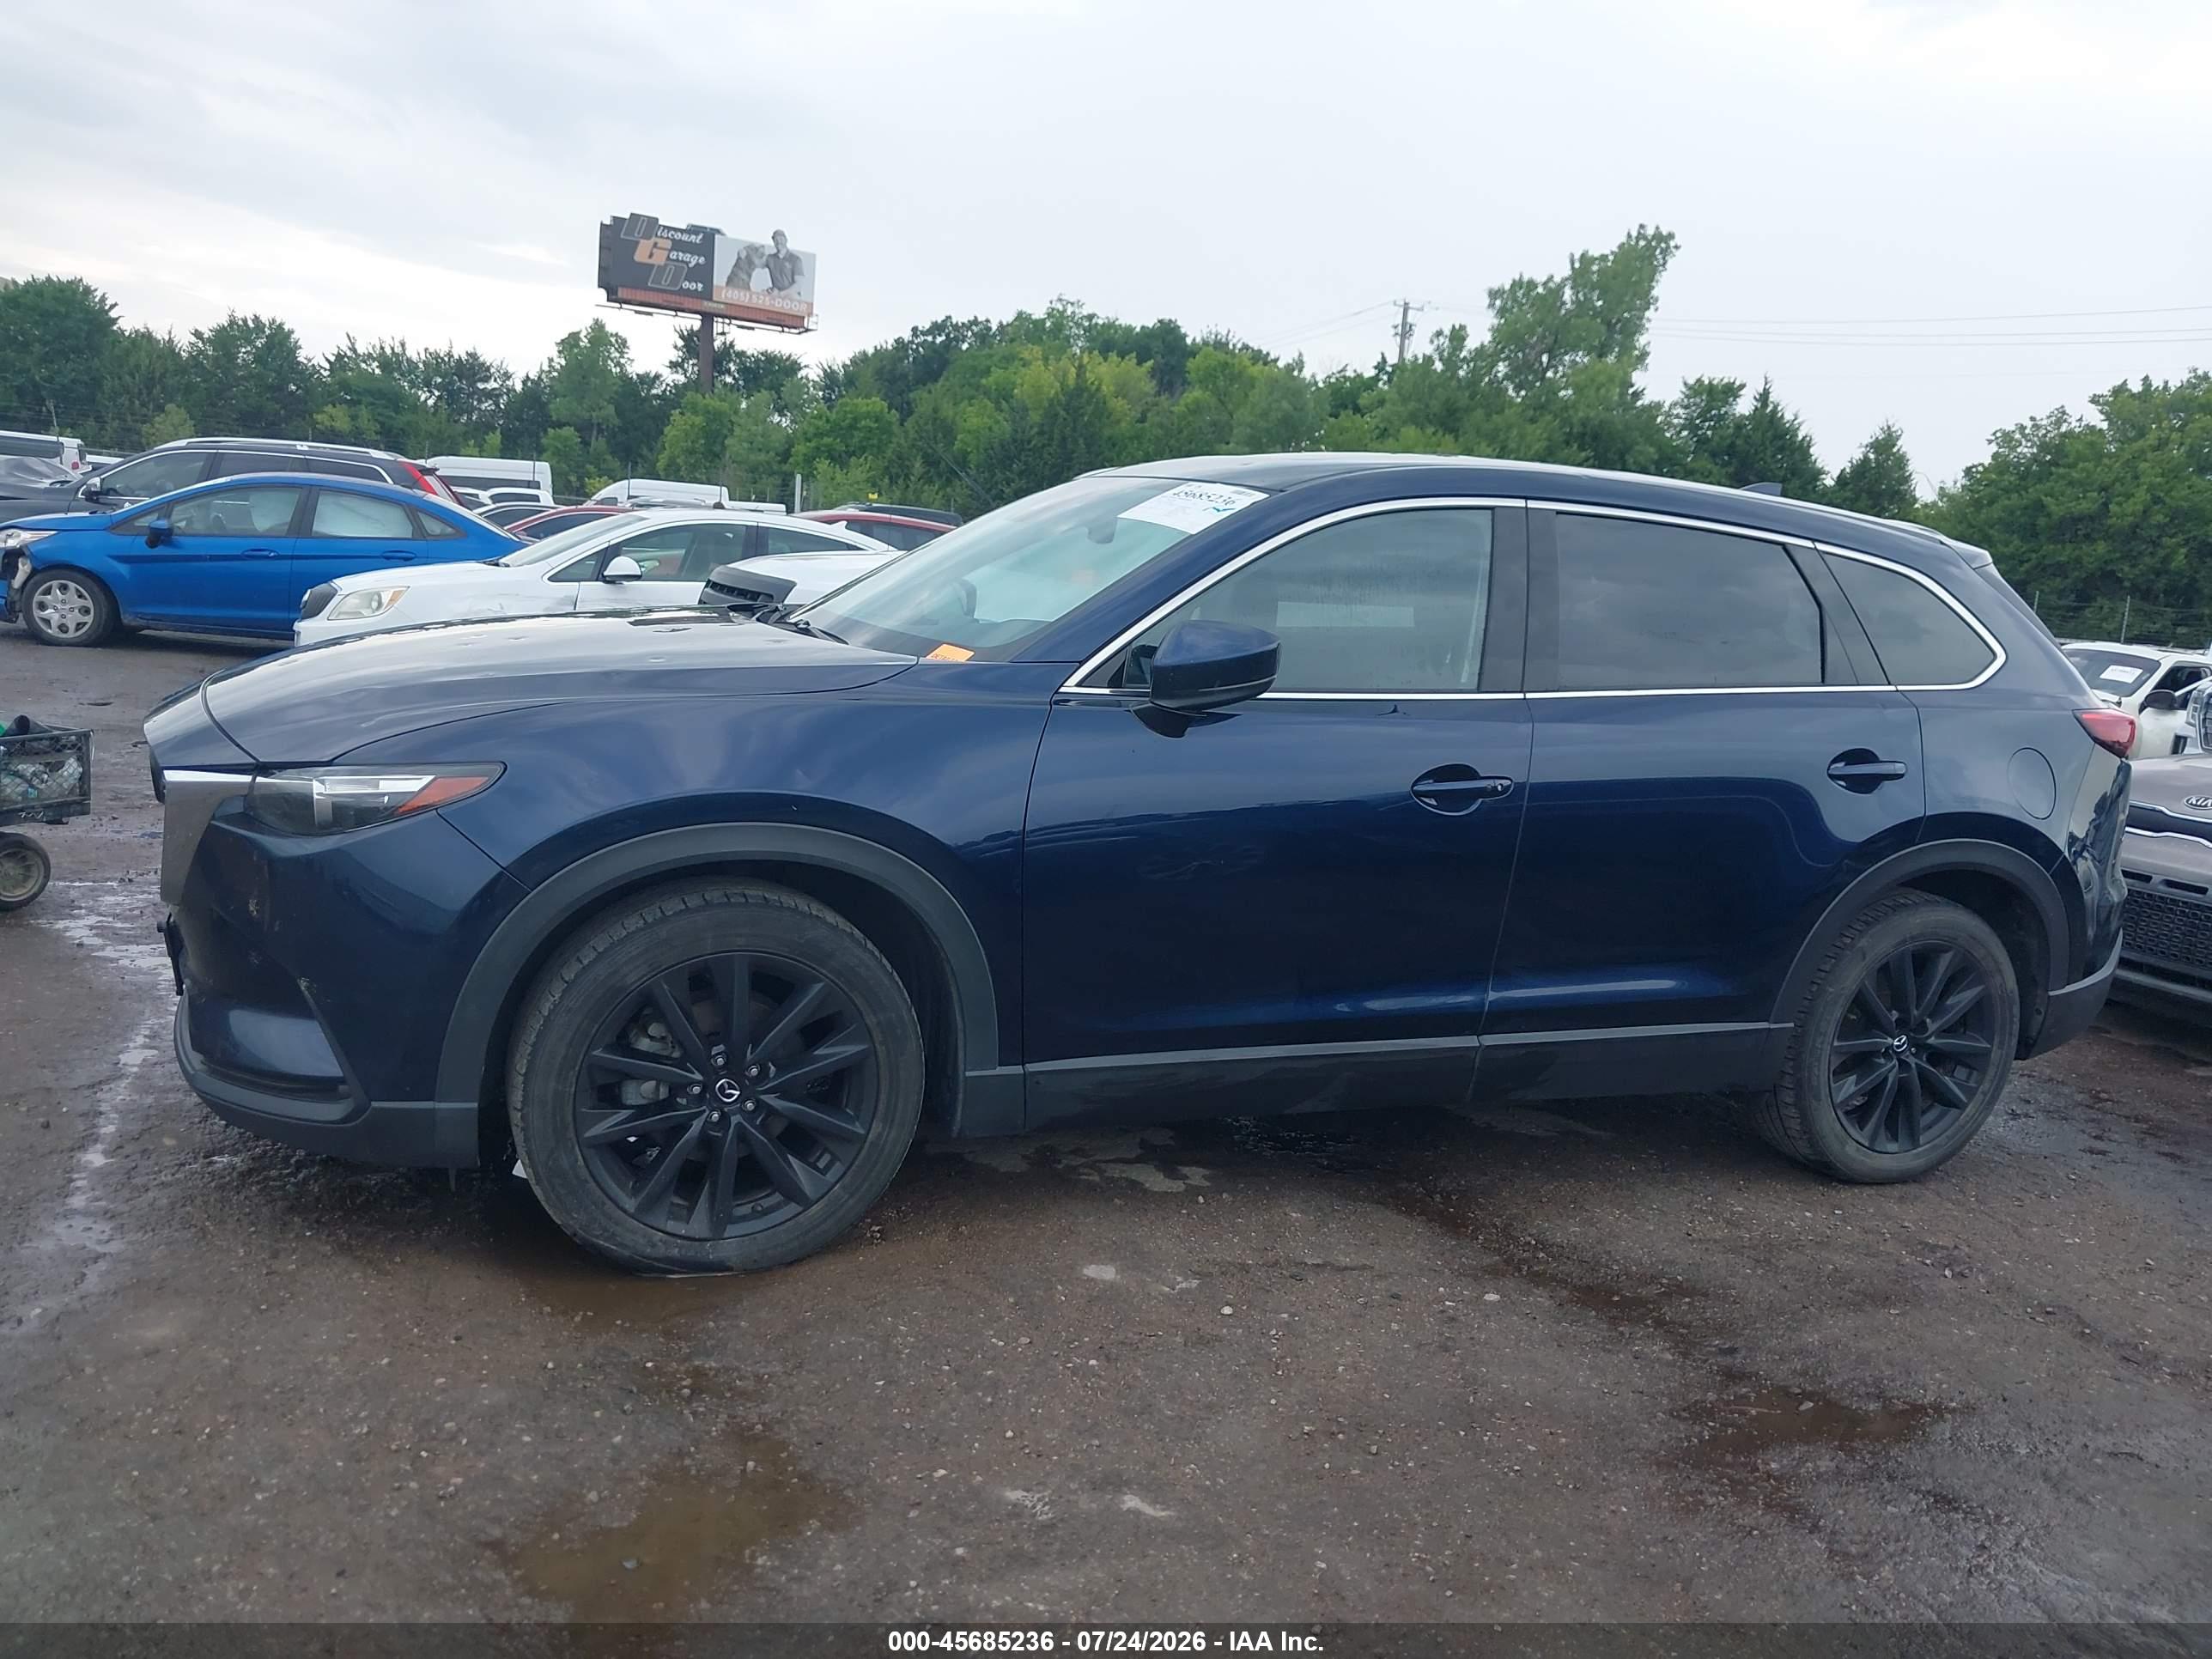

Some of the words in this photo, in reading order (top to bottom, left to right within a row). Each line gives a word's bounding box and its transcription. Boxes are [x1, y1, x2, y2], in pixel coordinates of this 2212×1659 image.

[620, 212, 704, 244] Discount
[634, 237, 706, 268] Garage
[647, 261, 703, 291] Door
